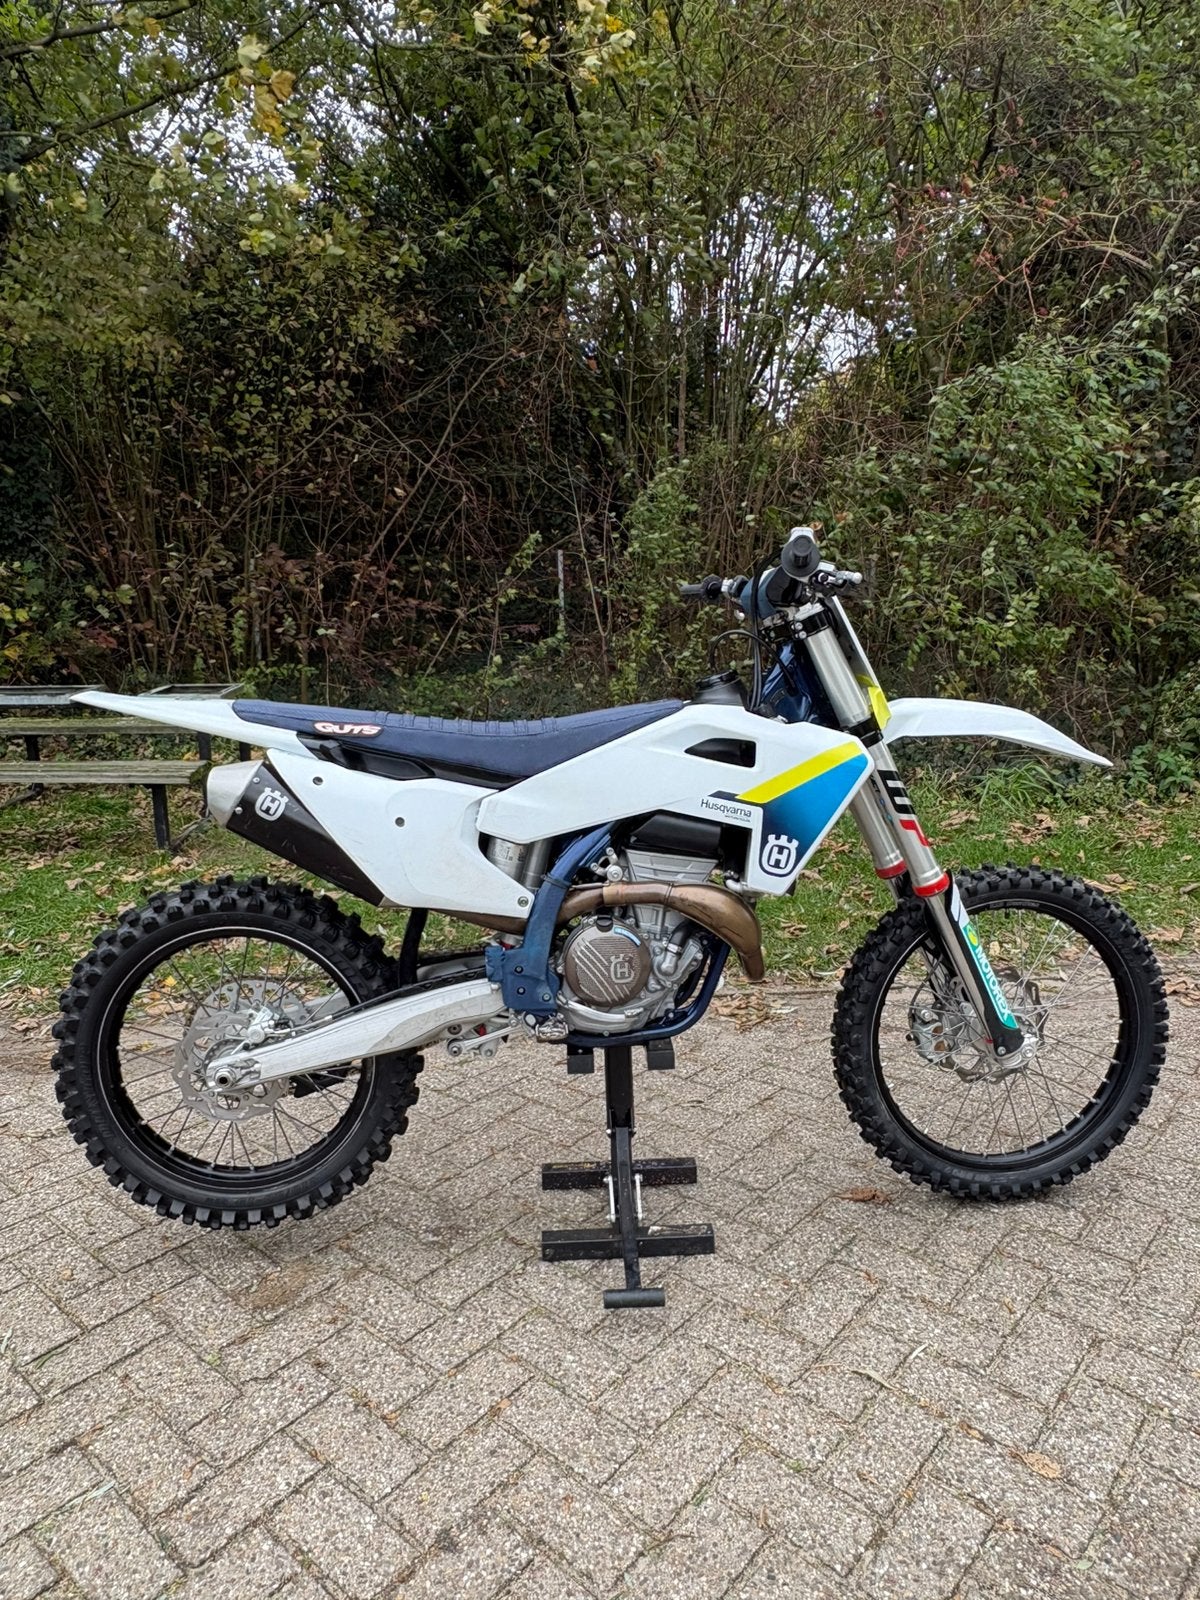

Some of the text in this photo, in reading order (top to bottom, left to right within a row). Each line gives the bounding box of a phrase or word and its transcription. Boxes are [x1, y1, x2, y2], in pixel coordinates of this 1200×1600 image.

[314, 721, 381, 735] GUTS
[700, 798, 752, 818] Husqvarna
[975, 945, 1012, 1022] MOTOREX
